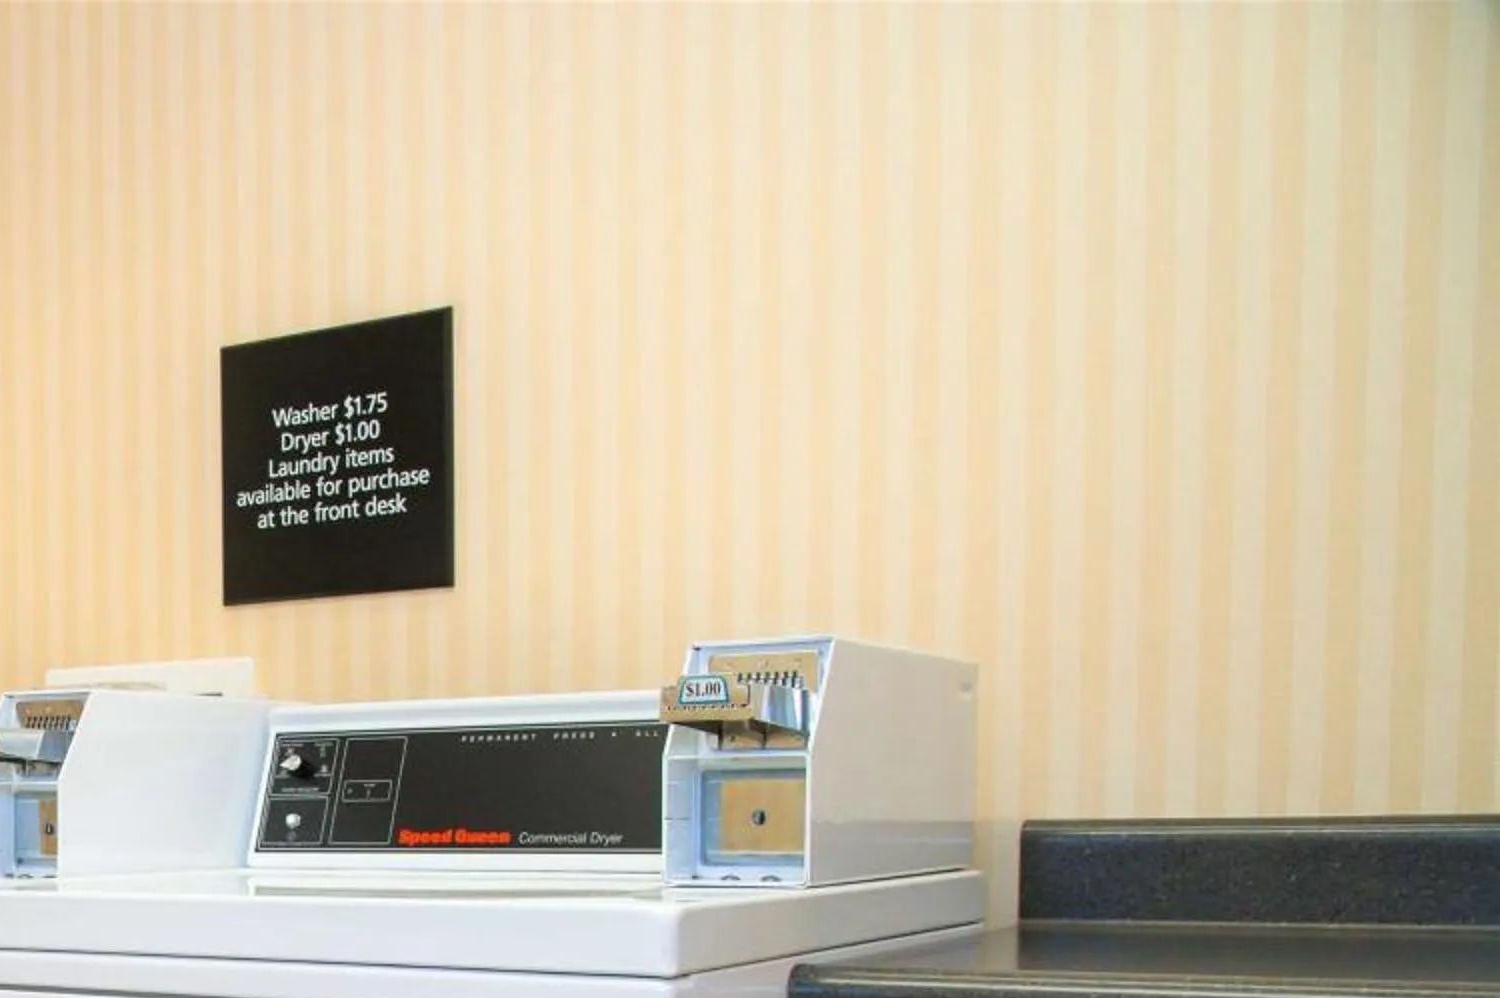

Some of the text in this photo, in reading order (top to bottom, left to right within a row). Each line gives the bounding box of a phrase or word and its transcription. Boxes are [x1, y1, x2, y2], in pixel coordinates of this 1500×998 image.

[272, 392, 388, 428] Washer $1.75
[281, 419, 380, 453] Dryer $1.00
[268, 446, 395, 477] Laundry items
[236, 468, 430, 507] available for purchase
[257, 494, 407, 529] at the front desk
[685, 682, 722, 697] $1.00
[400, 829, 624, 847] Speed Queen Commercial Dryer
